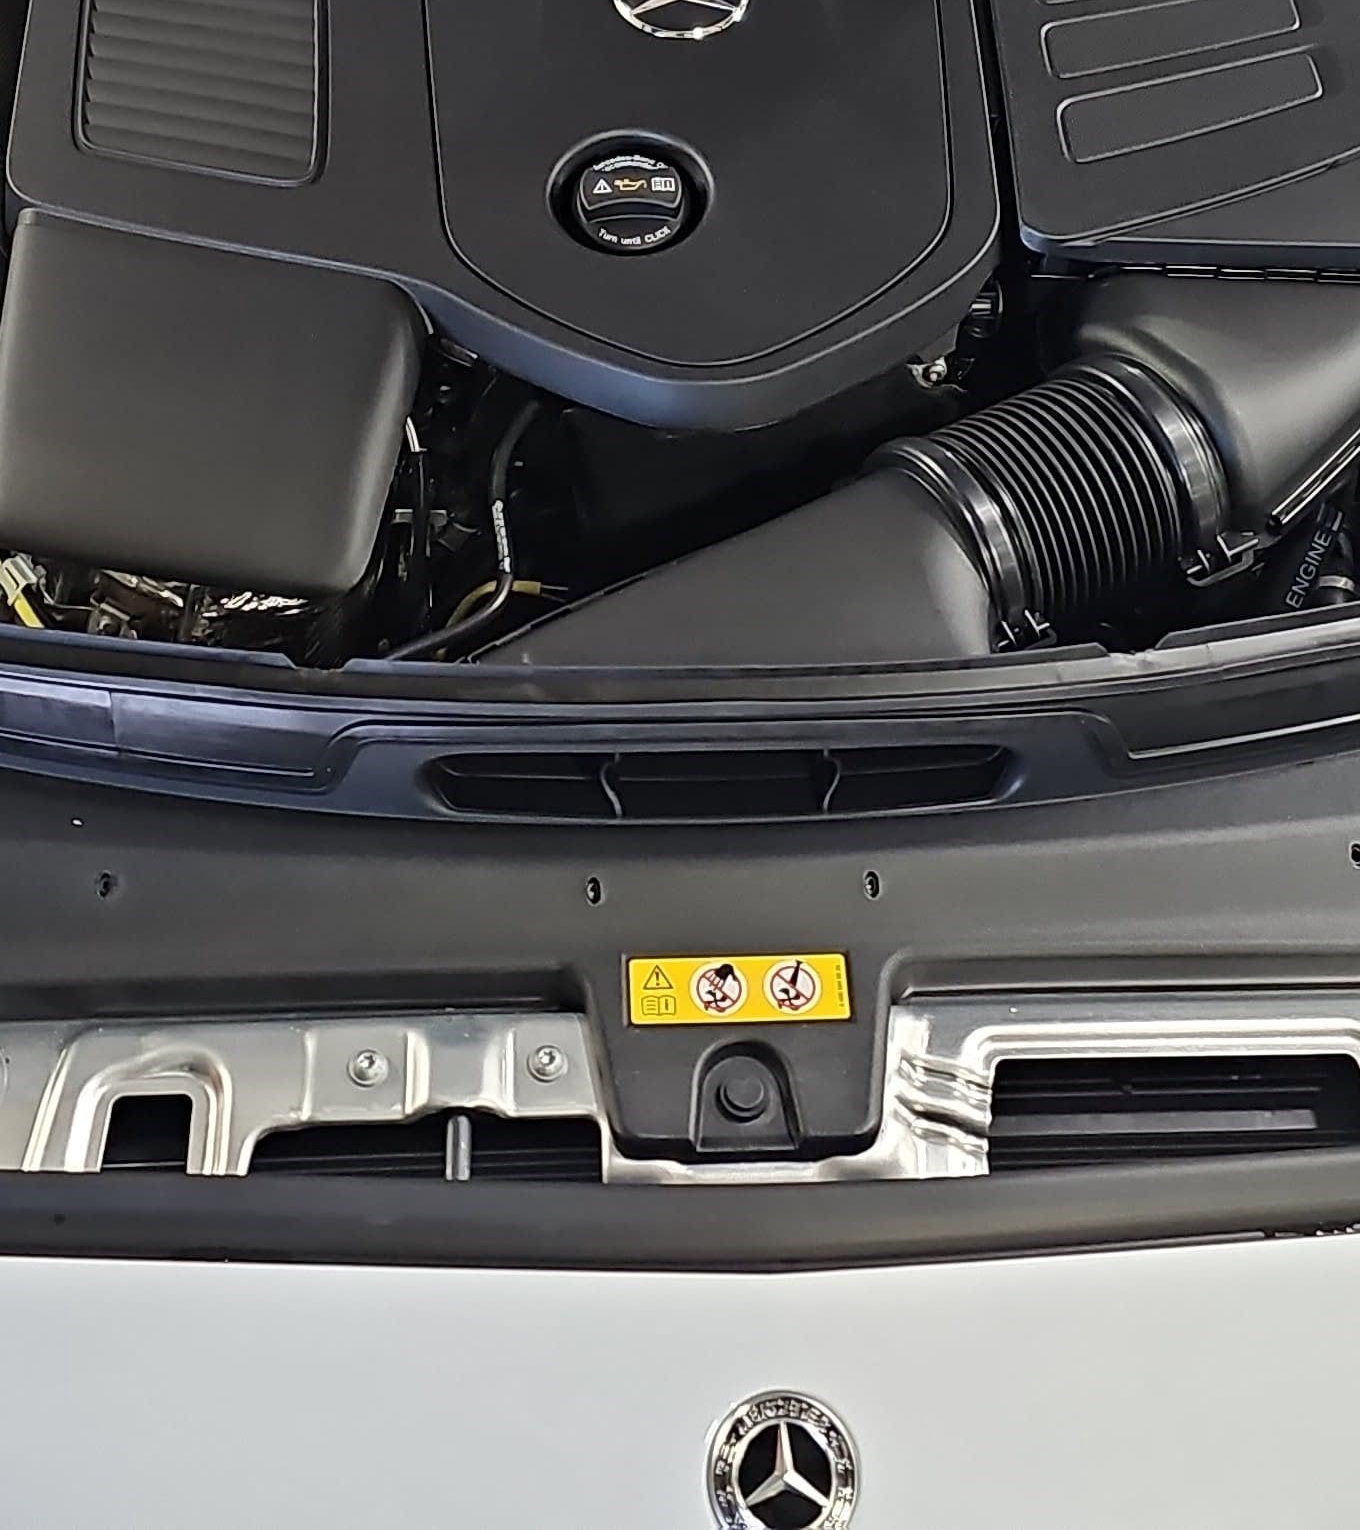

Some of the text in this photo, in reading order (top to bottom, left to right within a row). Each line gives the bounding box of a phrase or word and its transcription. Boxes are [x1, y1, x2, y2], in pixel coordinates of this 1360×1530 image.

[598, 228, 618, 244] Turn
[644, 225, 671, 243] CLICK
[1286, 530, 1332, 610] ENGINE
